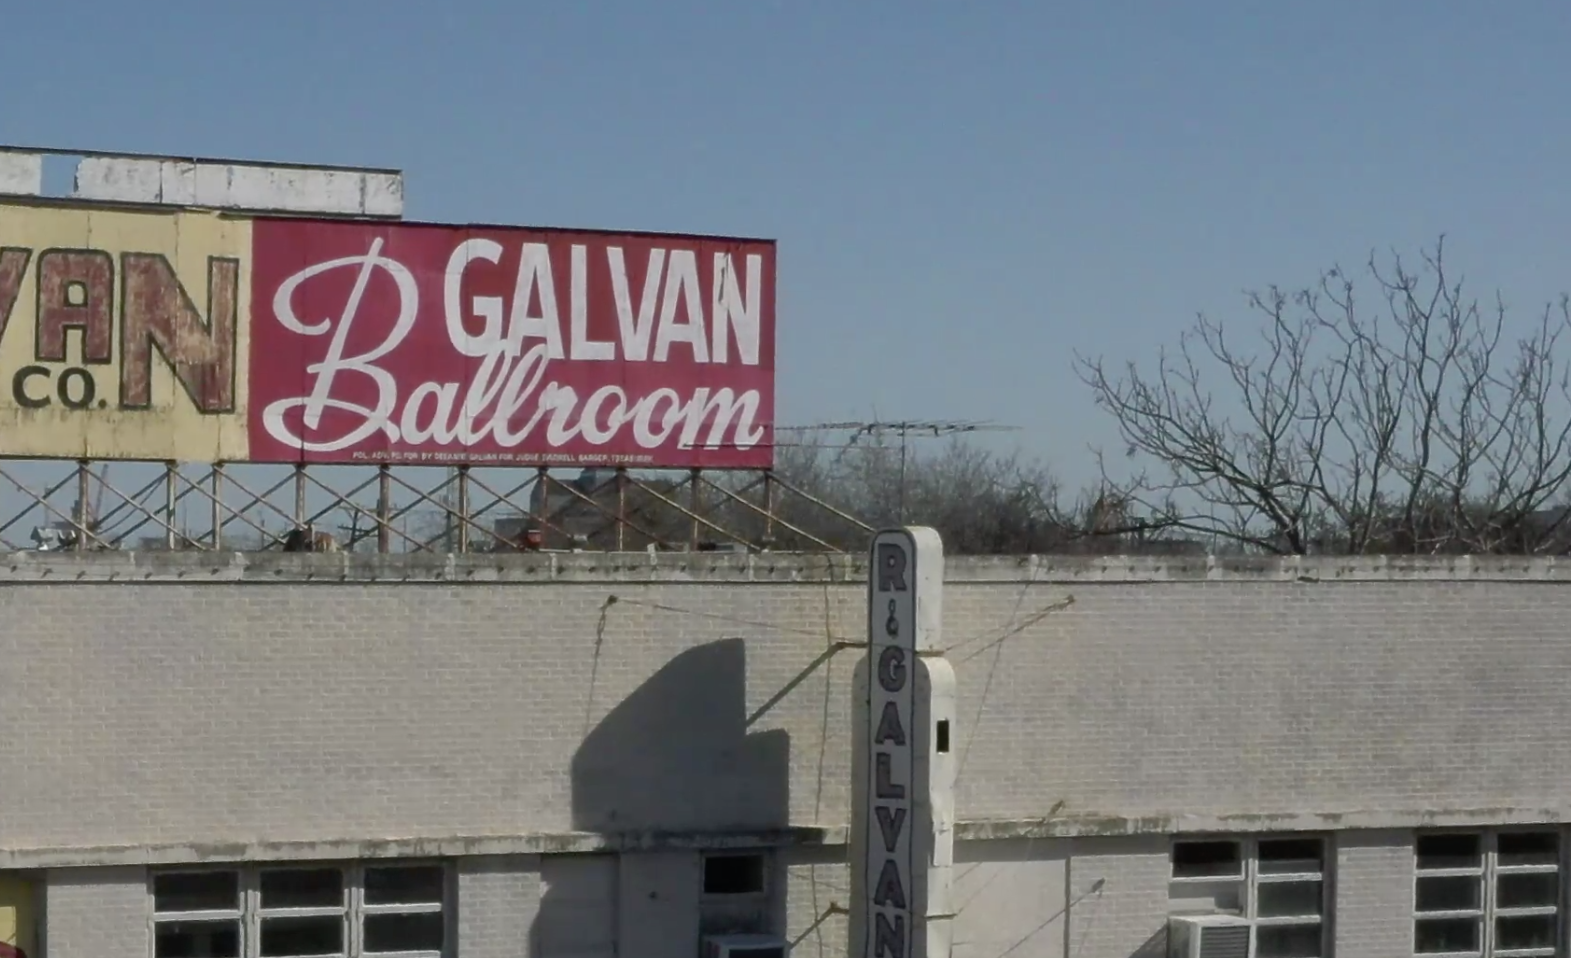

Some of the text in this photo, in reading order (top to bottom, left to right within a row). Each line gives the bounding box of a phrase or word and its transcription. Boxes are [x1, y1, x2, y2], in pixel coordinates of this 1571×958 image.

[262, 236, 764, 452] Ballroom
[444, 238, 762, 365] GALVAN
[12, 363, 108, 410] CO.
